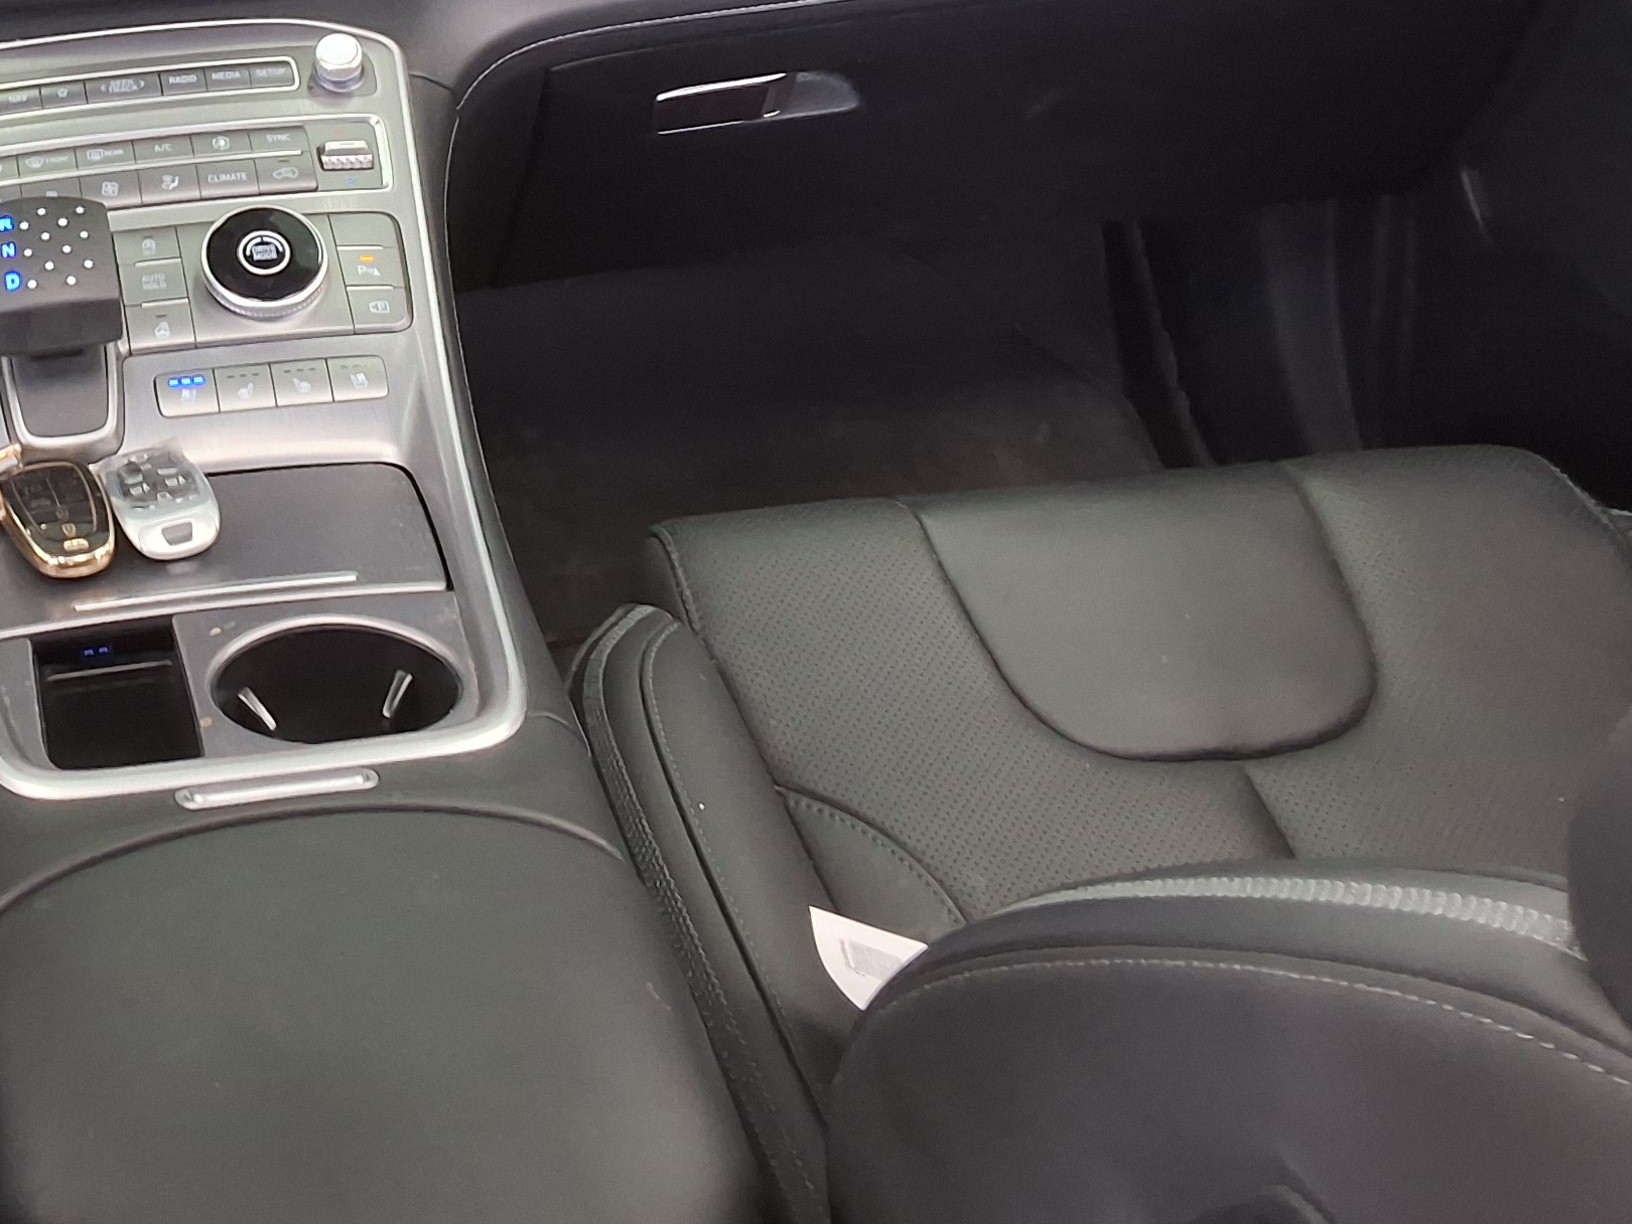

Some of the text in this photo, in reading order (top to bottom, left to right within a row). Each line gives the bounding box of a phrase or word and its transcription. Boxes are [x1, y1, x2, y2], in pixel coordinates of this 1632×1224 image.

[168, 74, 197, 84] RADIO
[211, 71, 241, 81] MEDIA
[265, 134, 291, 143] SYNC
[154, 143, 172, 153] A/C
[207, 172, 248, 183] CLIMATE
[0, 242, 17, 258] N
[4, 271, 22, 292] D
